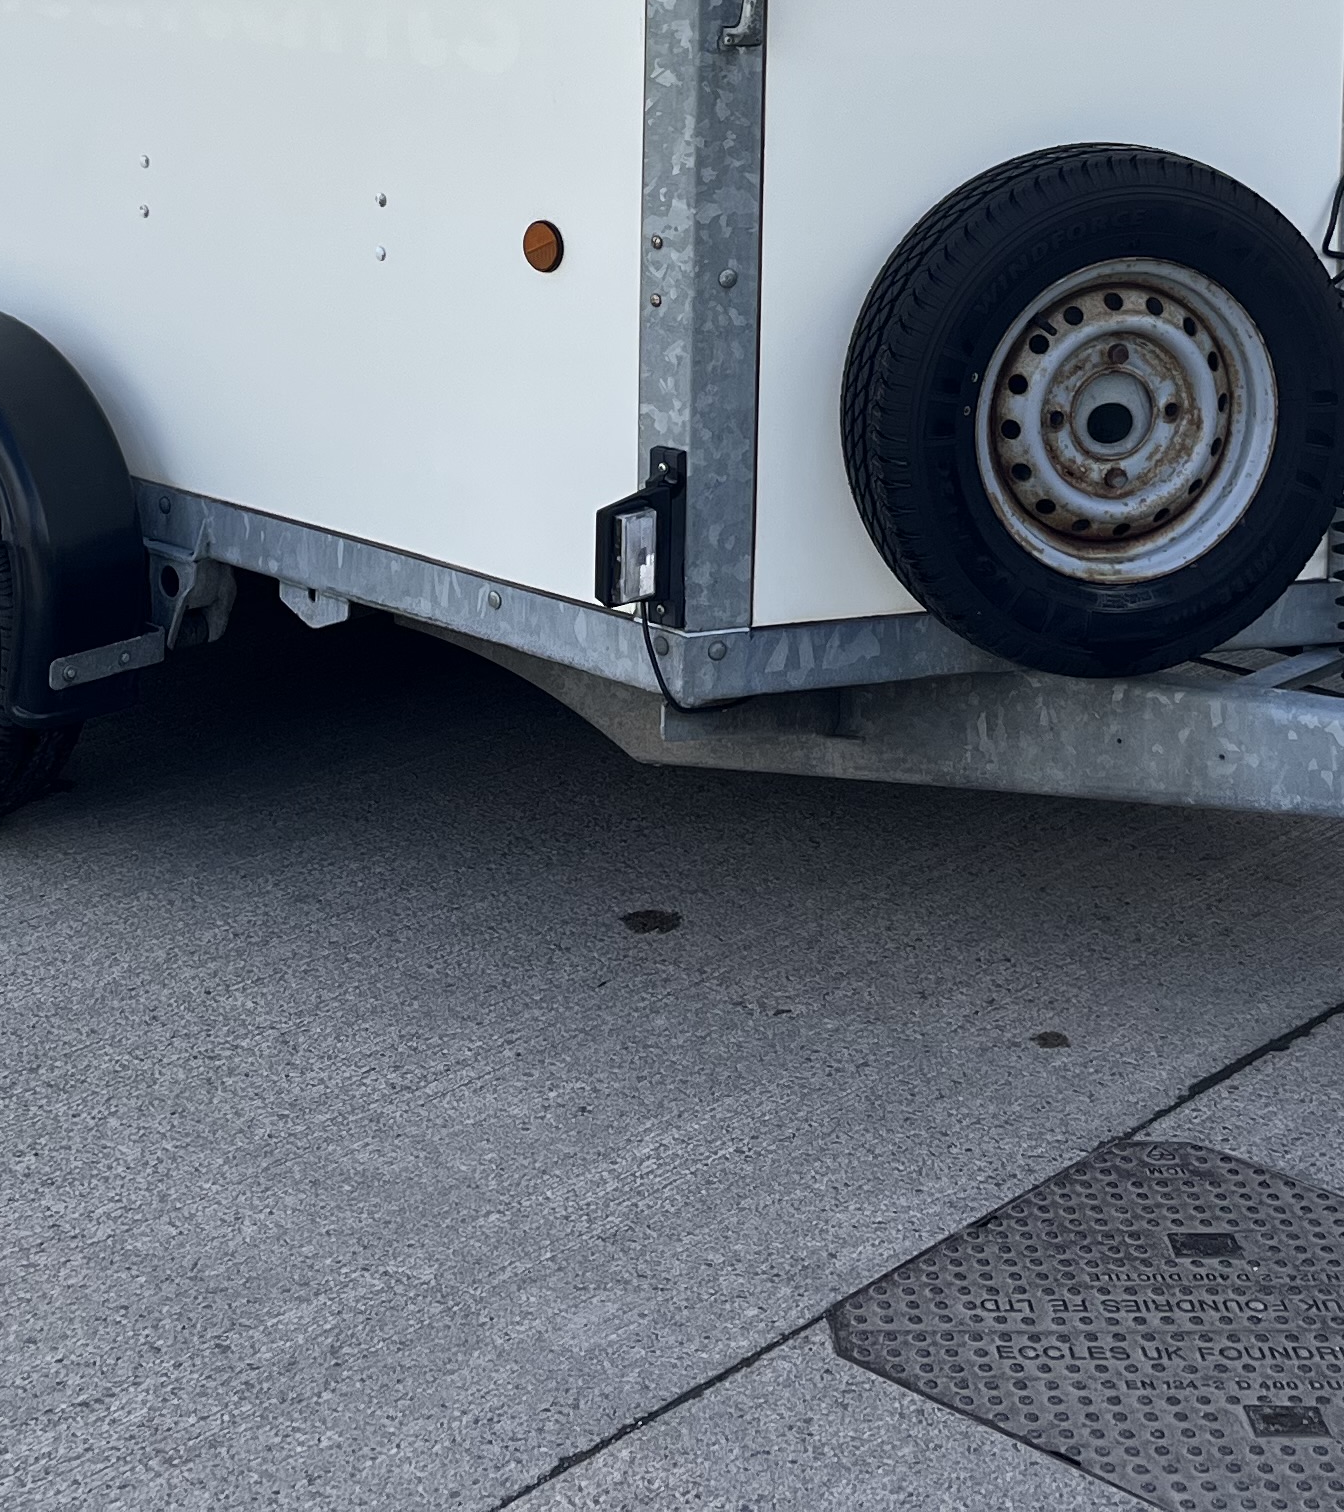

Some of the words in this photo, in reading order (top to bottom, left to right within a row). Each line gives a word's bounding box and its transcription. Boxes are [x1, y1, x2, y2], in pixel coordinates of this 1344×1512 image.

[979, 1298, 1035, 1314] LTD
[1047, 1298, 1090, 1313] FE
[1099, 1298, 1290, 1314] FOUNDRIES
[996, 1345, 1131, 1361] ECCLES
[1140, 1345, 1188, 1362] UK
[1124, 1379, 1156, 1391] EN
[1235, 1379, 1252, 1391] D
